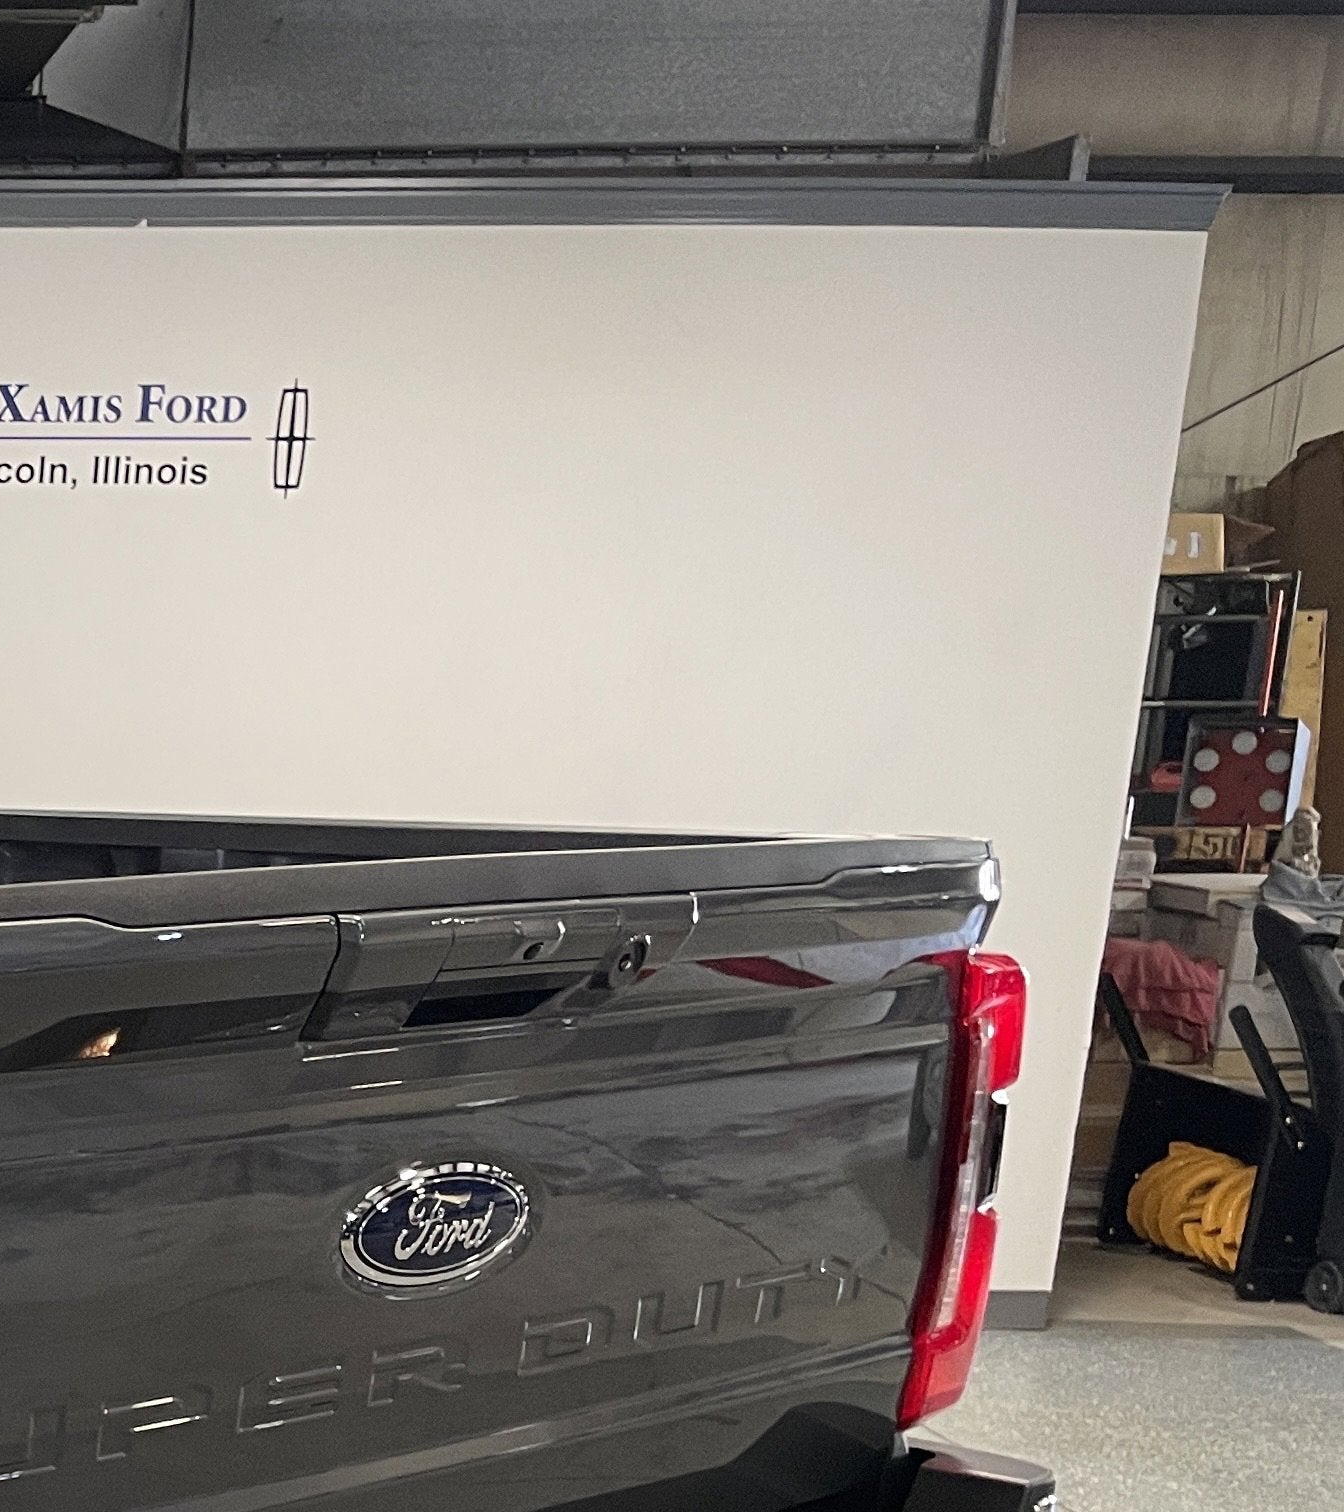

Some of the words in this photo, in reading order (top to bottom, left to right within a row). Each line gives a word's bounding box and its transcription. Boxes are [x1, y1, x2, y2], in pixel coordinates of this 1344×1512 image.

[92, 456, 208, 487] Illinois
[393, 1191, 495, 1261] Ford
[518, 1243, 889, 1377] DUTY
